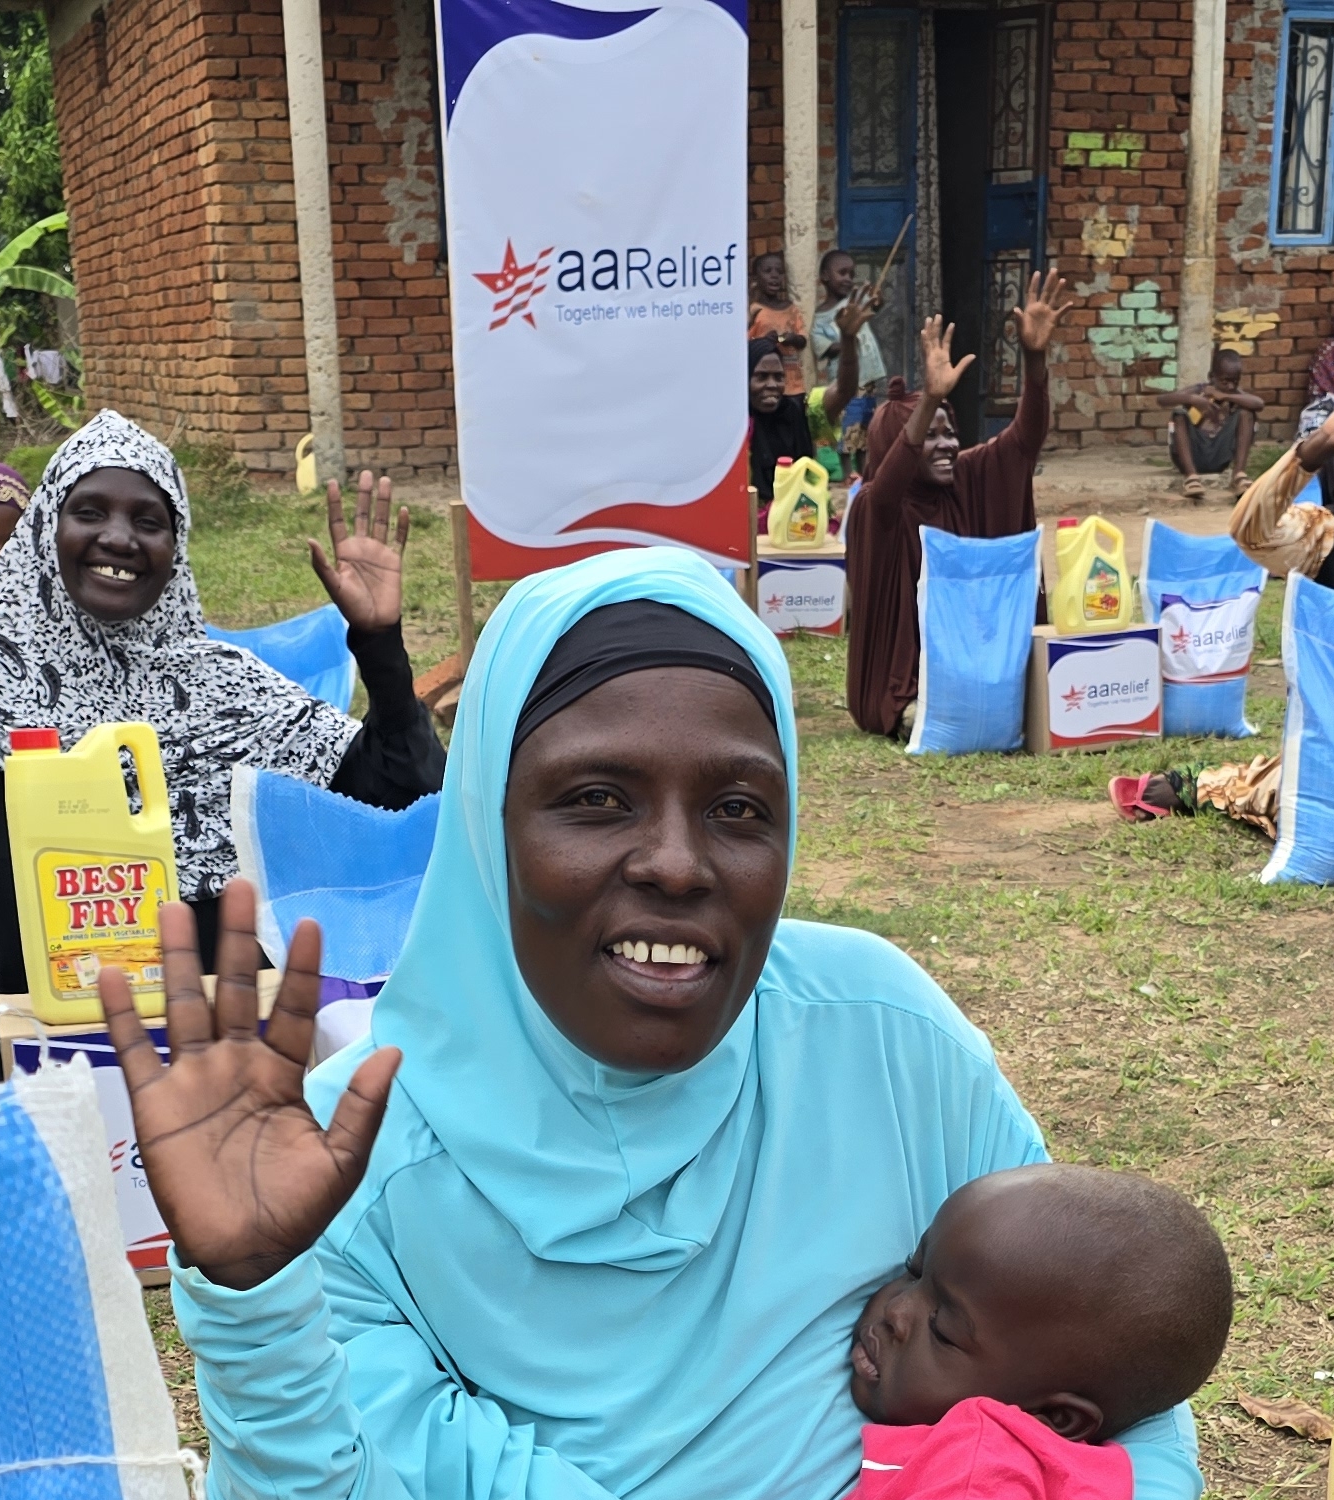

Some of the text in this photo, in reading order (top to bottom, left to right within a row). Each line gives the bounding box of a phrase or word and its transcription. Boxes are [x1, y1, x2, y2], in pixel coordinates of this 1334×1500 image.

[556, 243, 738, 292] aaRelief
[555, 298, 734, 325] Together we help others
[1087, 678, 1150, 699] aaRelief
[55, 863, 148, 897] BEST
[69, 897, 142, 929] FRY
